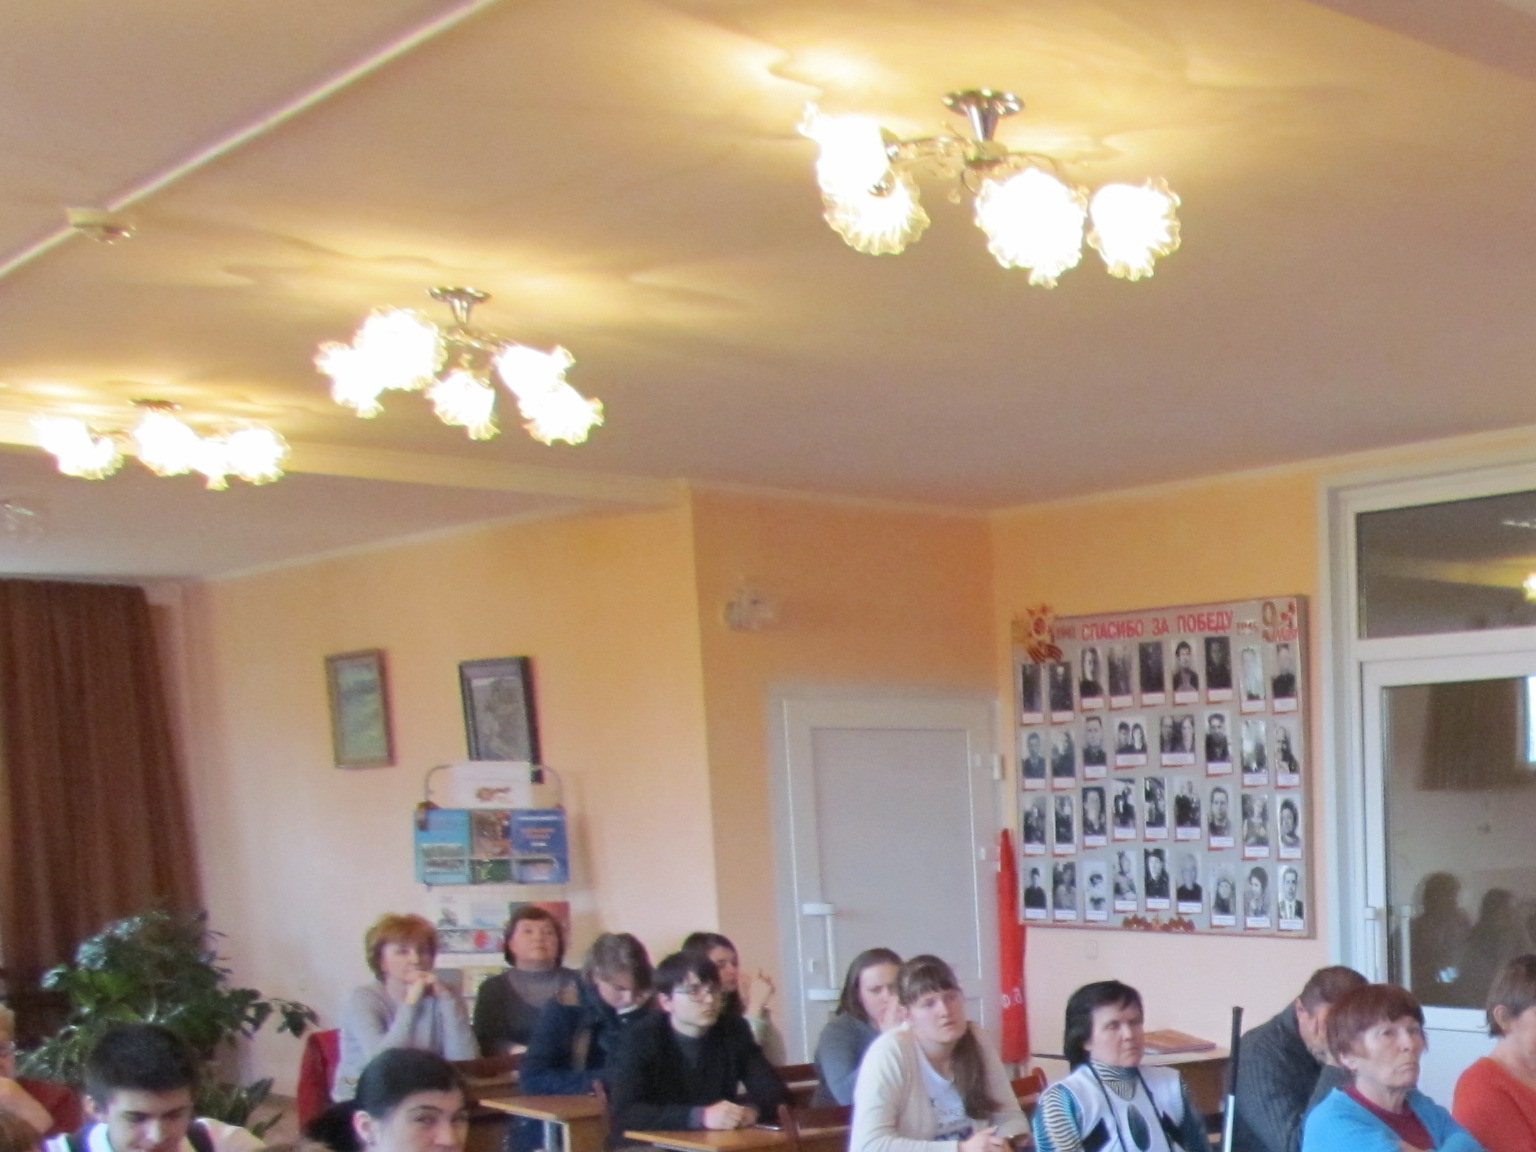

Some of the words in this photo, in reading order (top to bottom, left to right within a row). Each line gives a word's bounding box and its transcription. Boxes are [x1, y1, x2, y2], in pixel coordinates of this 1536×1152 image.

[1082, 619, 1144, 641] СПАСИБО
[1152, 617, 1170, 636] ЗА
[1176, 610, 1233, 634] ПОБЕДУ
